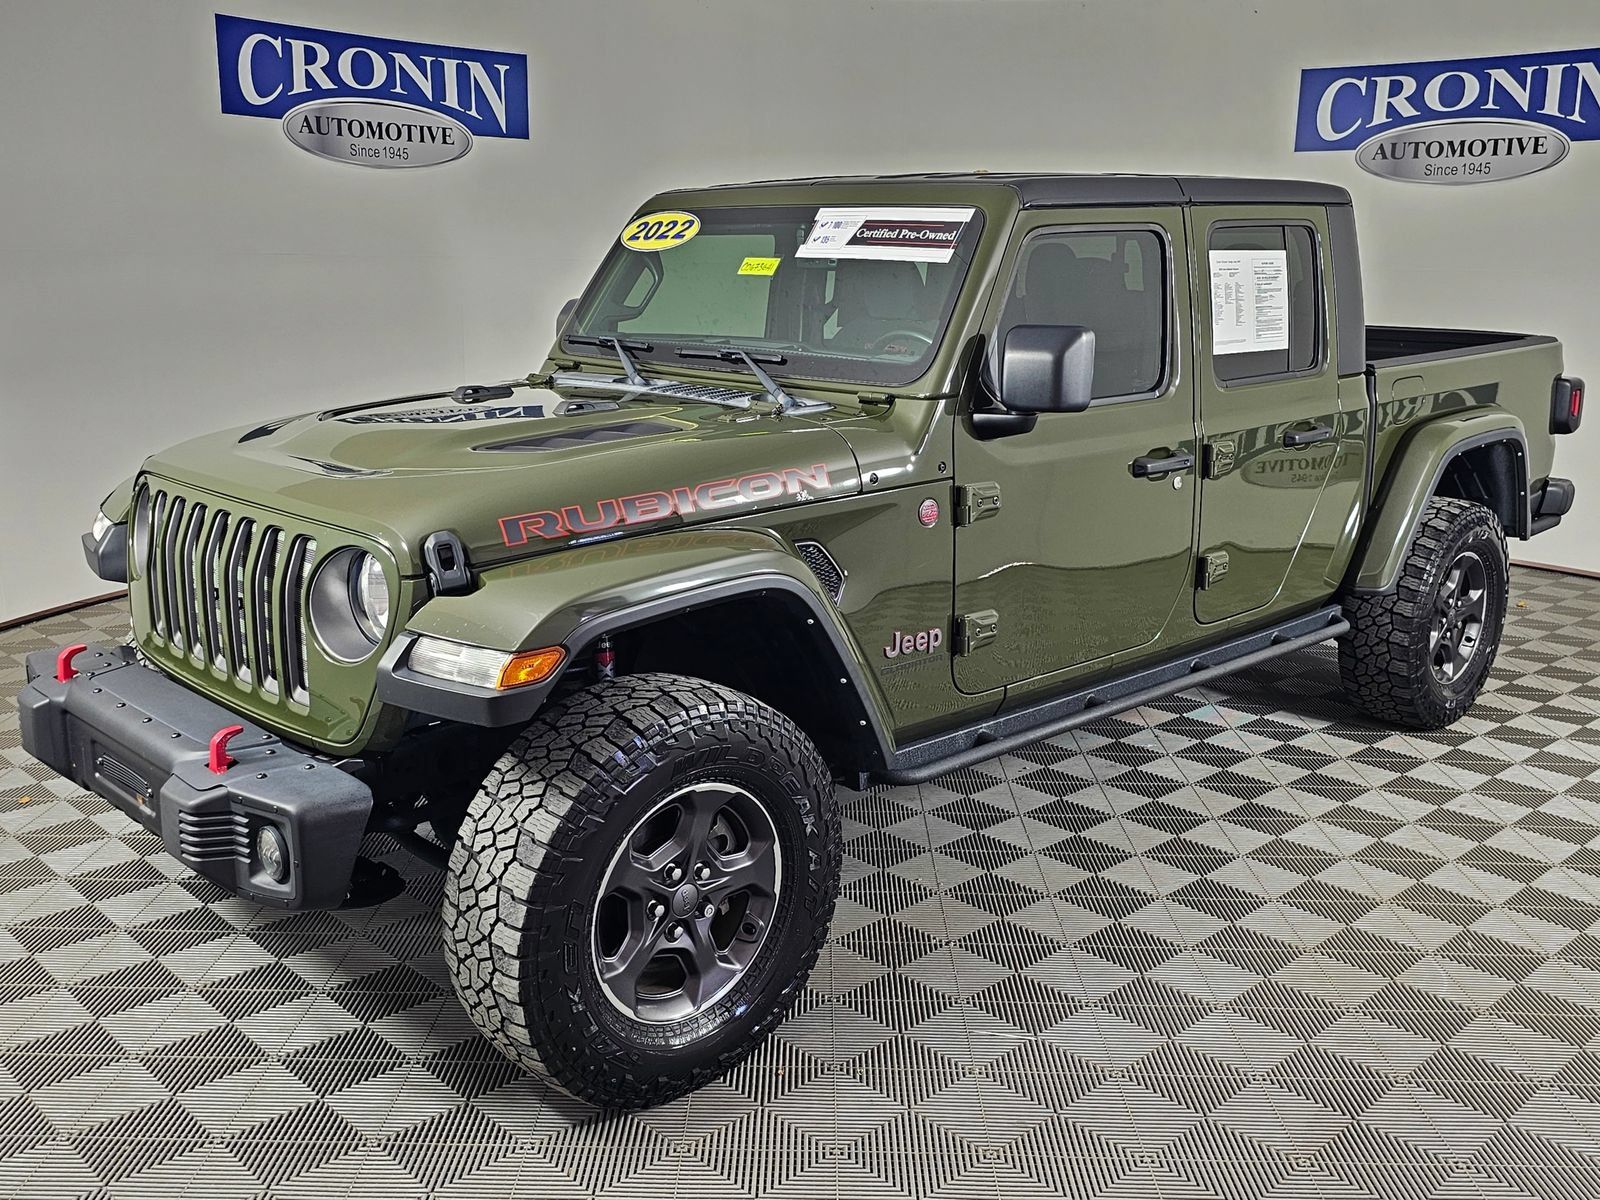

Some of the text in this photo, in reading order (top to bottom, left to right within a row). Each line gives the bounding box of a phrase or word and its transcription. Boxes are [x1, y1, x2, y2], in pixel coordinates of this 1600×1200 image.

[238, 33, 510, 134] CRONIN
[298, 114, 455, 146] AUTOMOTIVE
[349, 143, 409, 160] Since 1945
[1372, 136, 1548, 161] AUTOMOTIVE
[1424, 162, 1491, 176] Since 1945
[626, 219, 695, 241] 2022
[856, 228, 956, 241] Certified Pre-Owned
[498, 463, 832, 547] RUBICON
[883, 628, 942, 659] Jeep
